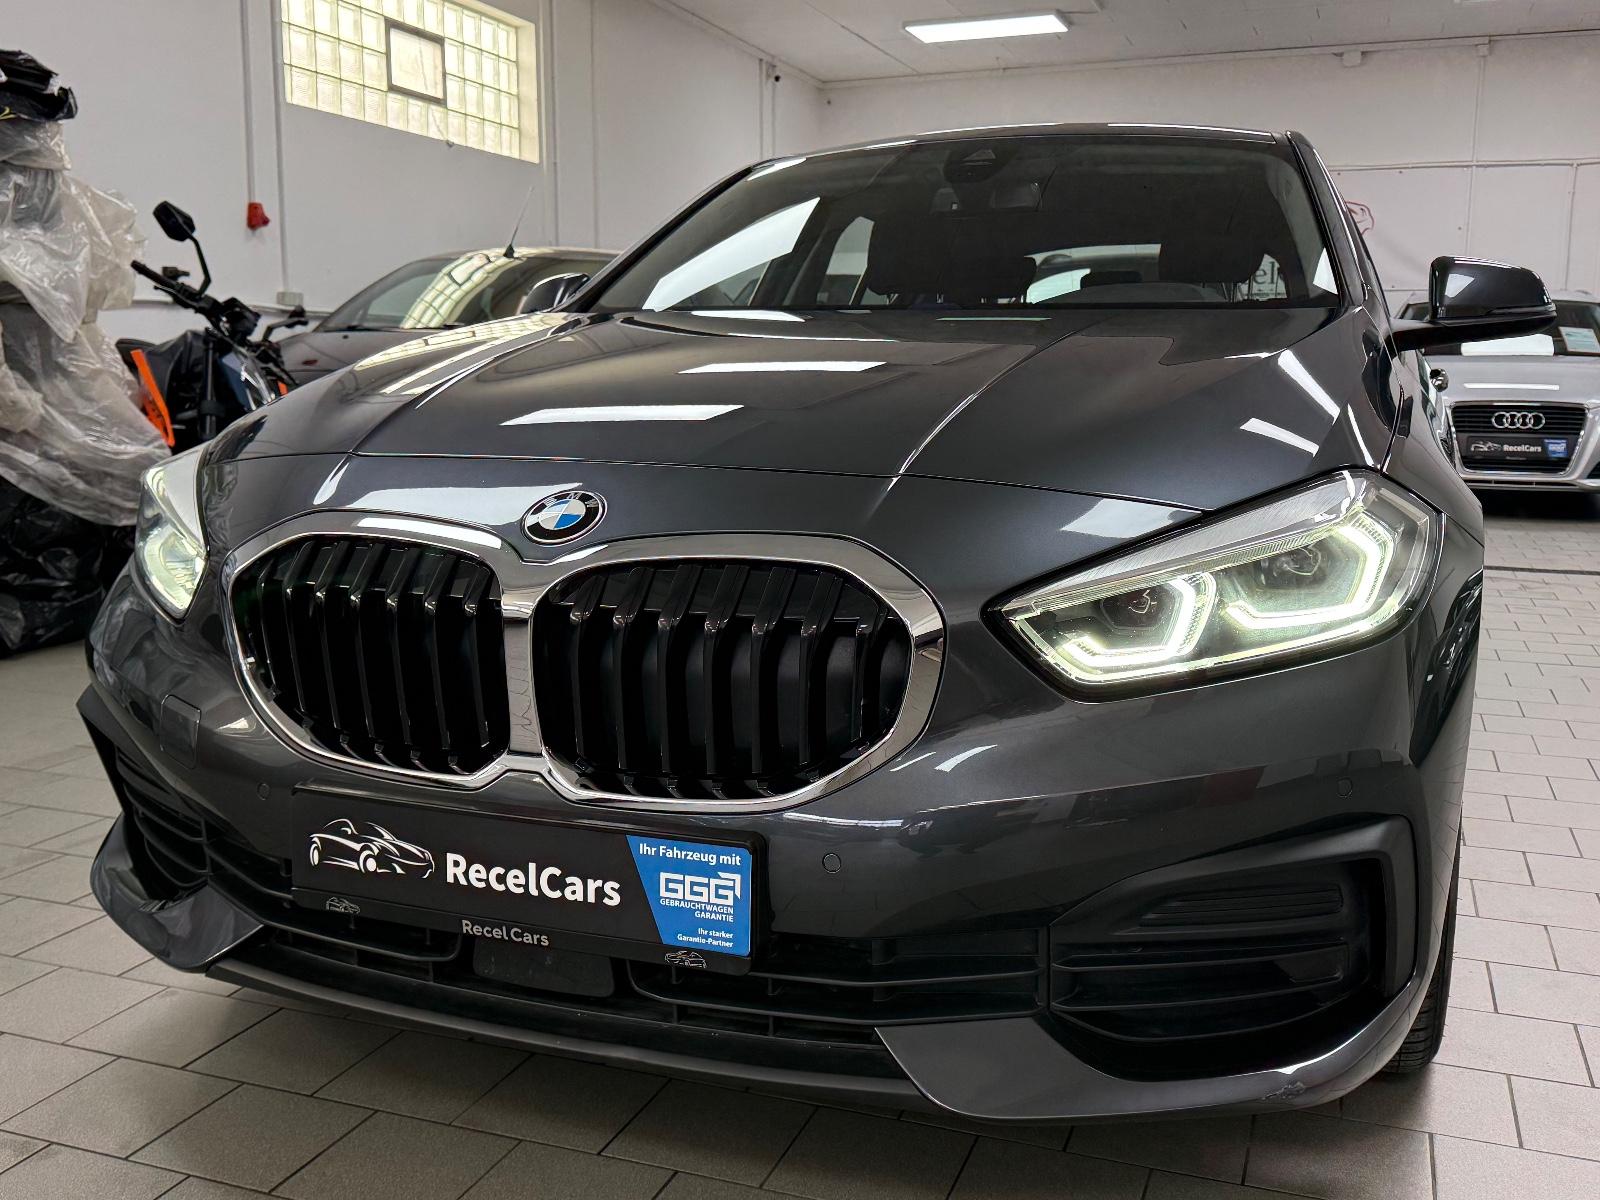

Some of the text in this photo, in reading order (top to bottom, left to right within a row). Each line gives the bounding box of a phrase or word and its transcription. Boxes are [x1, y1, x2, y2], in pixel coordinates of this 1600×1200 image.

[639, 843, 741, 866] Ihr Fahrzeug mit
[446, 852, 621, 907] RecelCars
[660, 871, 736, 906] GGG
[660, 898, 734, 914] GEBRAUCHTWAGEN
[694, 910, 734, 923] GARANTIE
[677, 933, 734, 948] Garantie-Partner
[698, 927, 734, 939] Ihr starker
